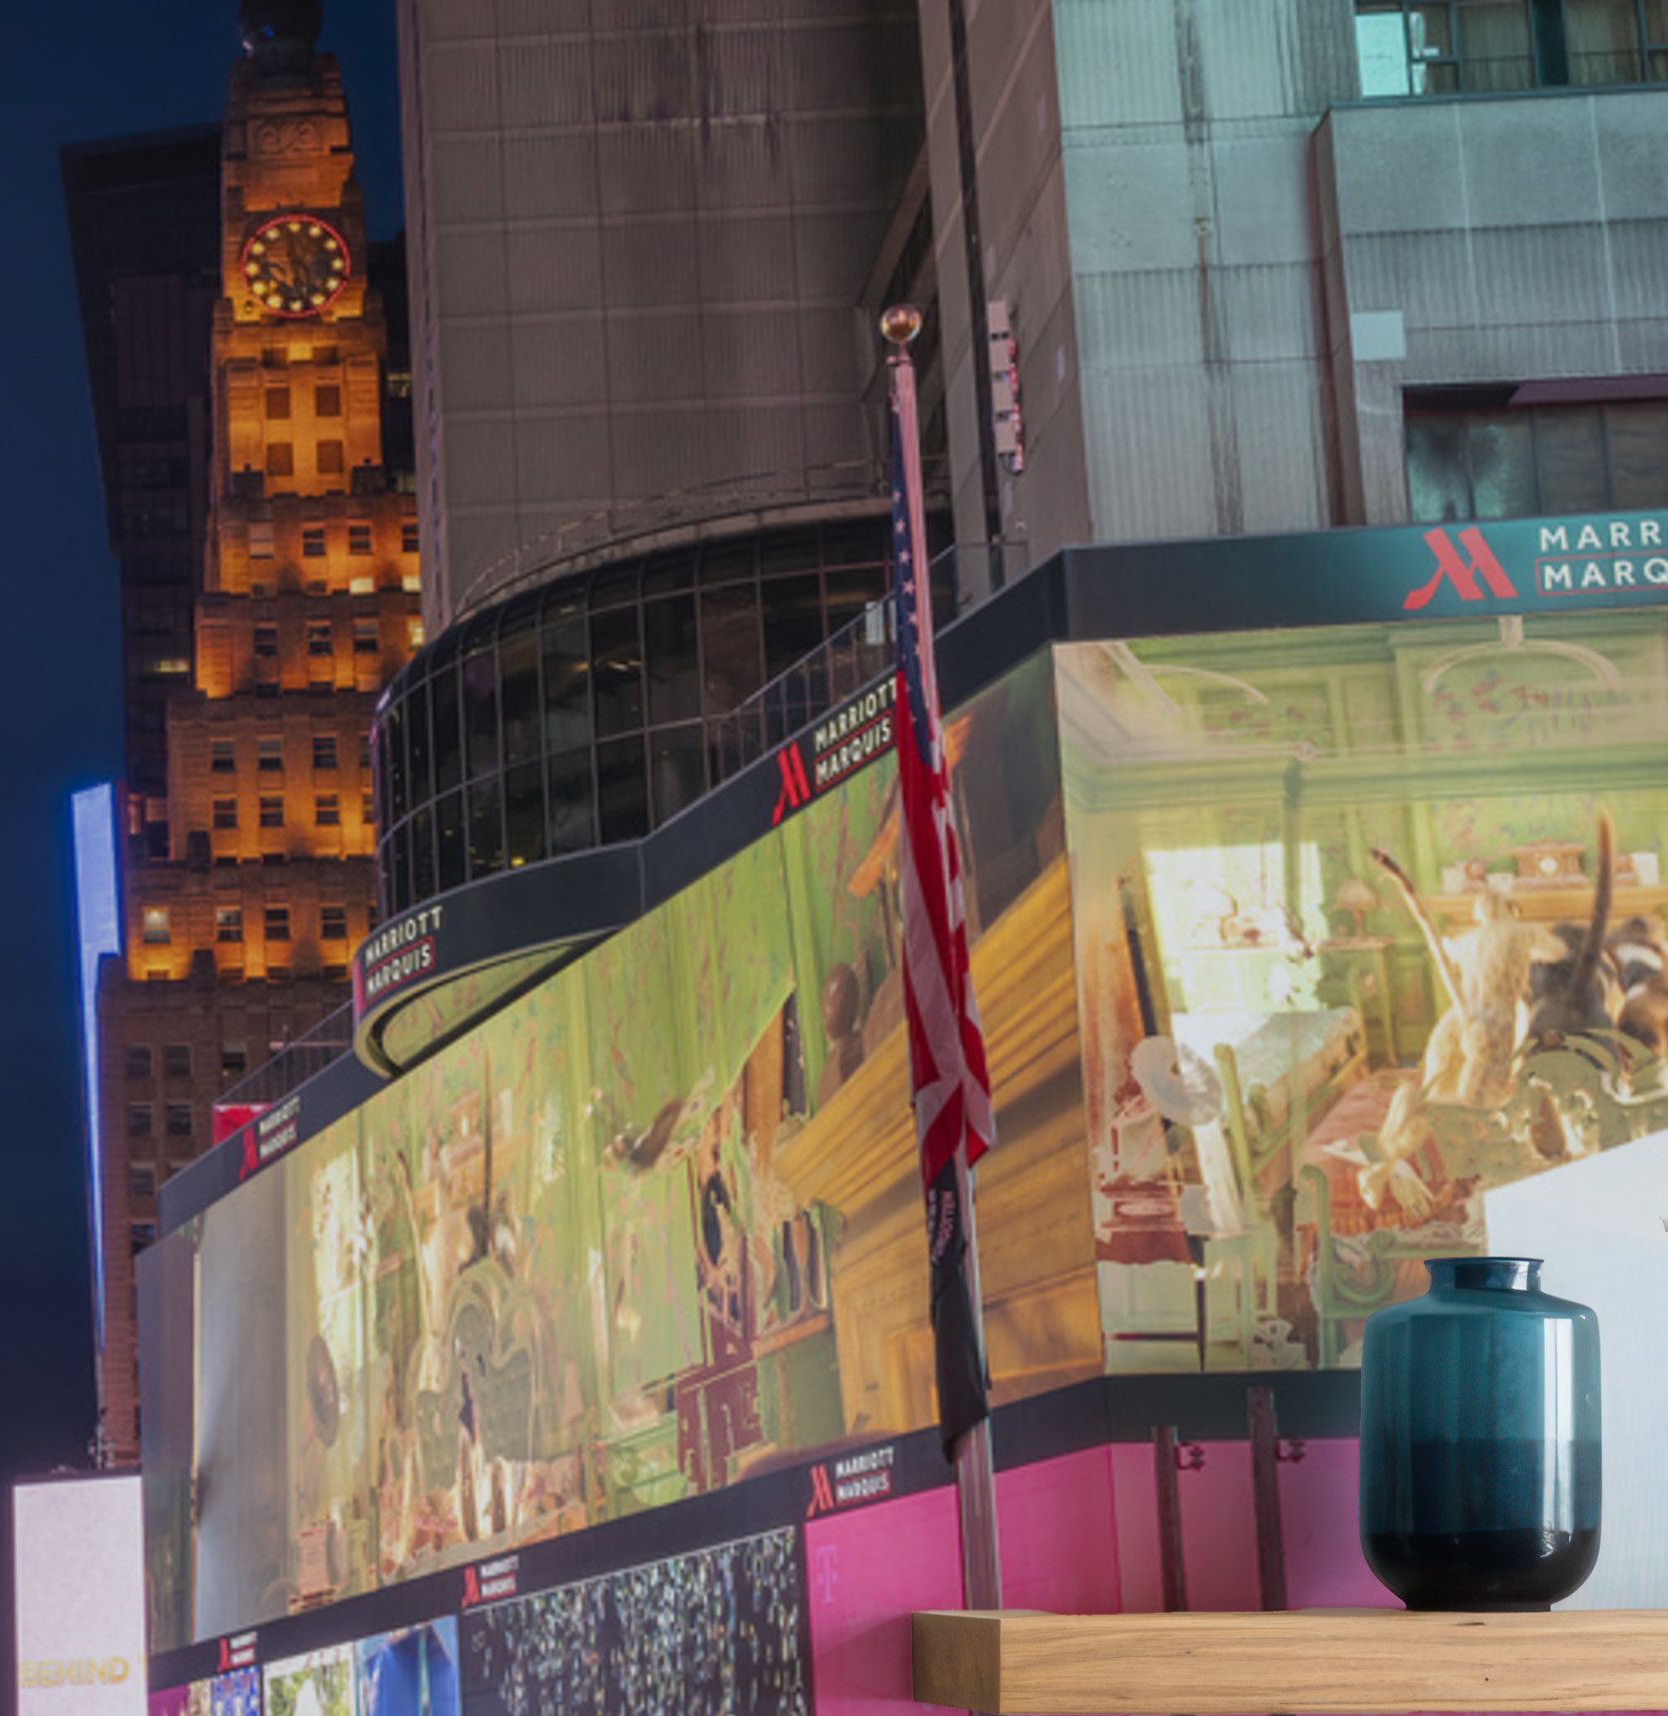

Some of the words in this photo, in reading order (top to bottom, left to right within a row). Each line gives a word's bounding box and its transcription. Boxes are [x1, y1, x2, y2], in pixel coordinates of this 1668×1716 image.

[814, 678, 898, 752] MARRIOTT
[816, 720, 893, 787] MARQUIS
[20, 1658, 130, 1689] BEHIND
